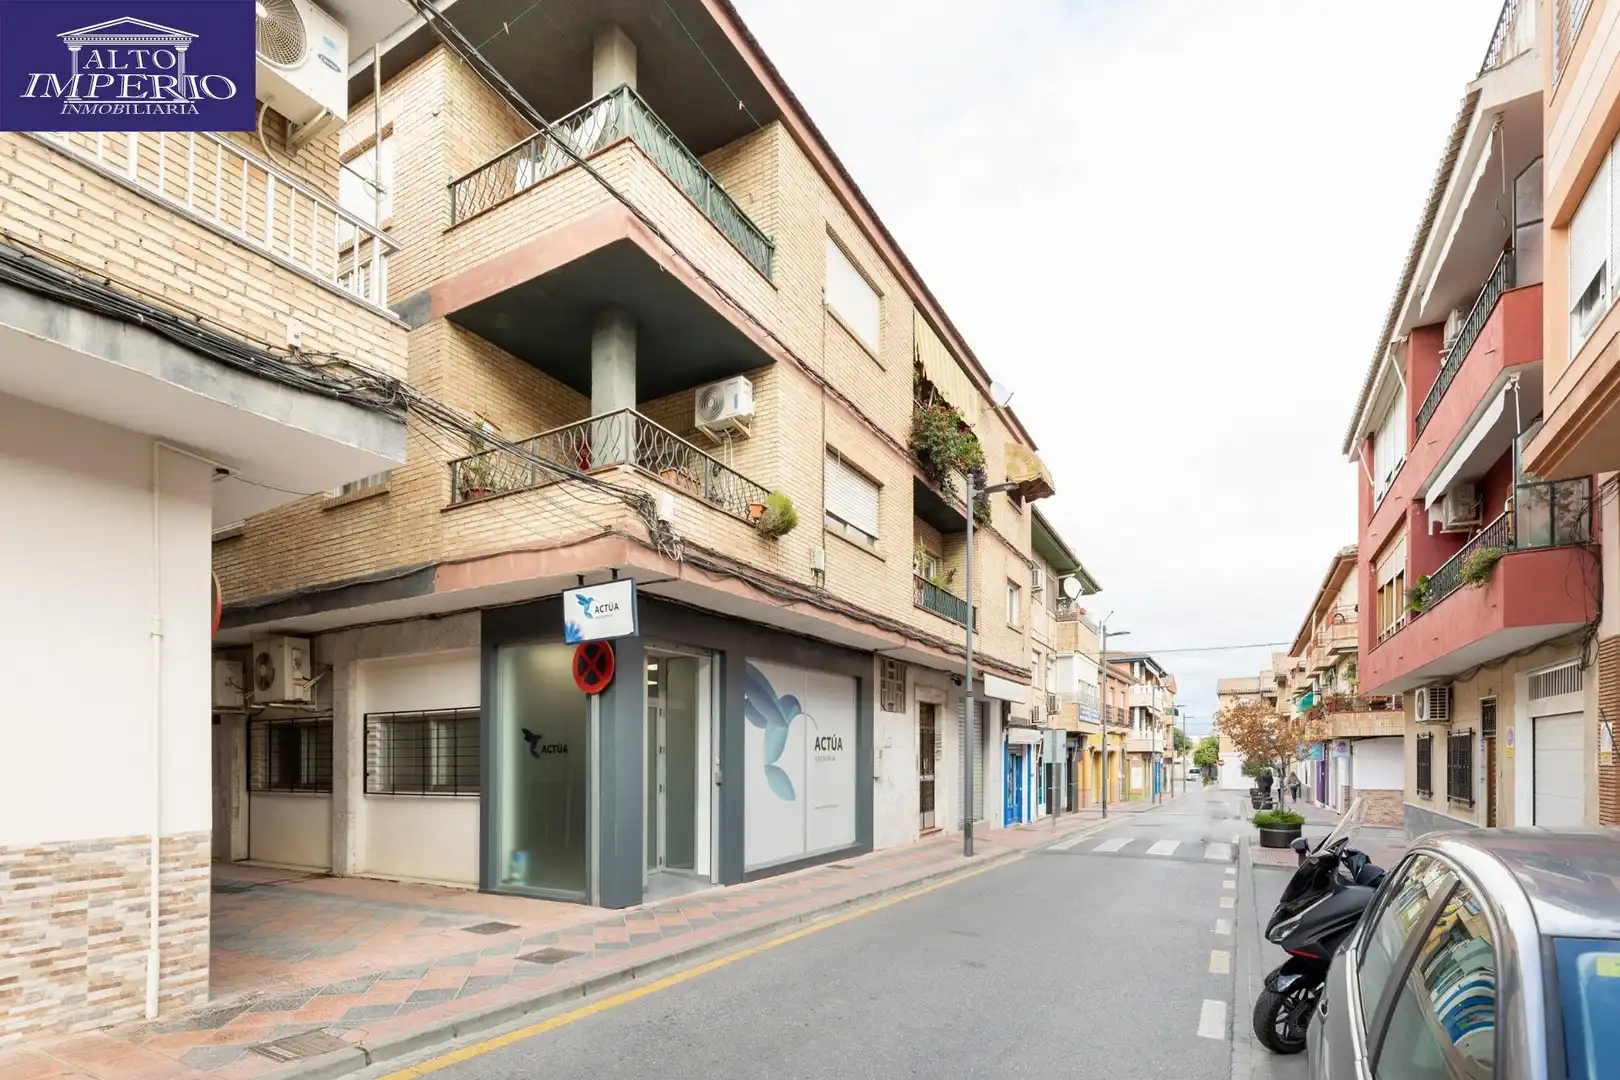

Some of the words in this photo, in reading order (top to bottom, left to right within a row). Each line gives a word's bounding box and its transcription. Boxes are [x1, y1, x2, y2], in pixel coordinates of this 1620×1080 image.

[594, 601, 619, 613] ACTÚA
[541, 743, 568, 754] ACTÚA
[814, 734, 843, 751] ACTÚA
